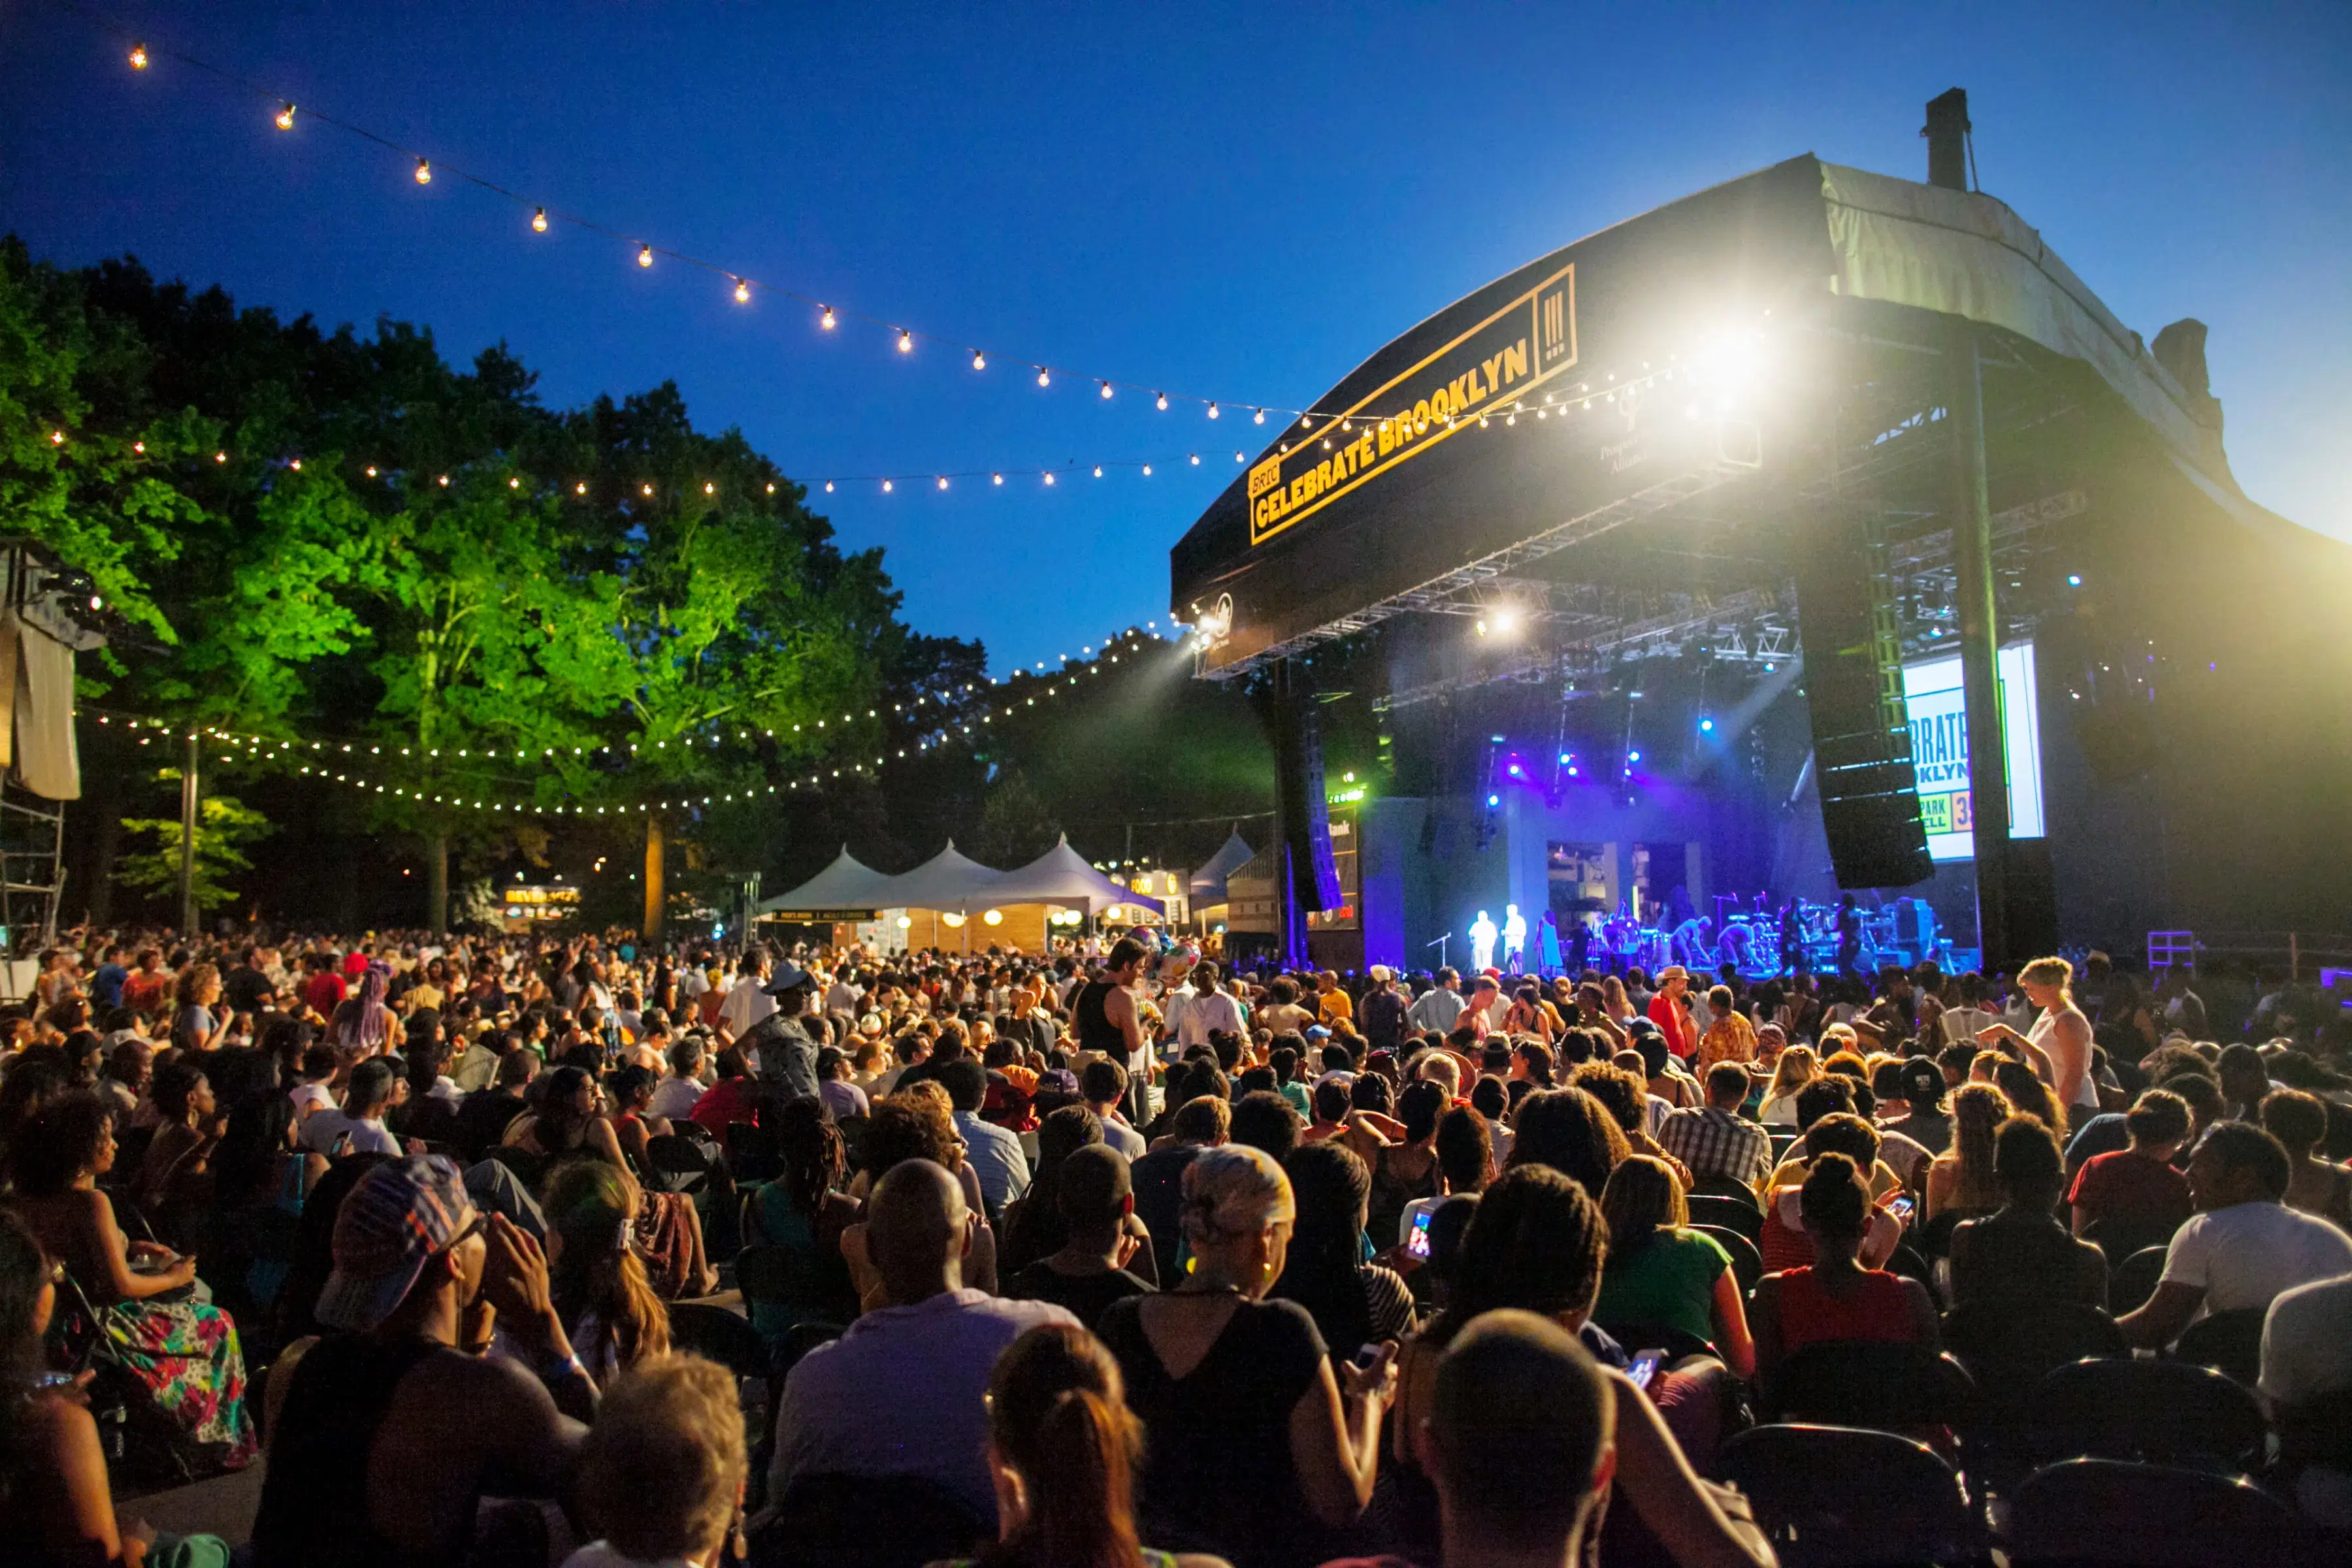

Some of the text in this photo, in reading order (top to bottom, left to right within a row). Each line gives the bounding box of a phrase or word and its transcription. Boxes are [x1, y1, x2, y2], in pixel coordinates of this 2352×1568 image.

[1256, 338, 1527, 528] CELEBRATE BROOKLYN
[1252, 464, 1277, 494] BRIC
[1916, 762, 1970, 783] KLYN
[1920, 798, 1946, 817] PARK
